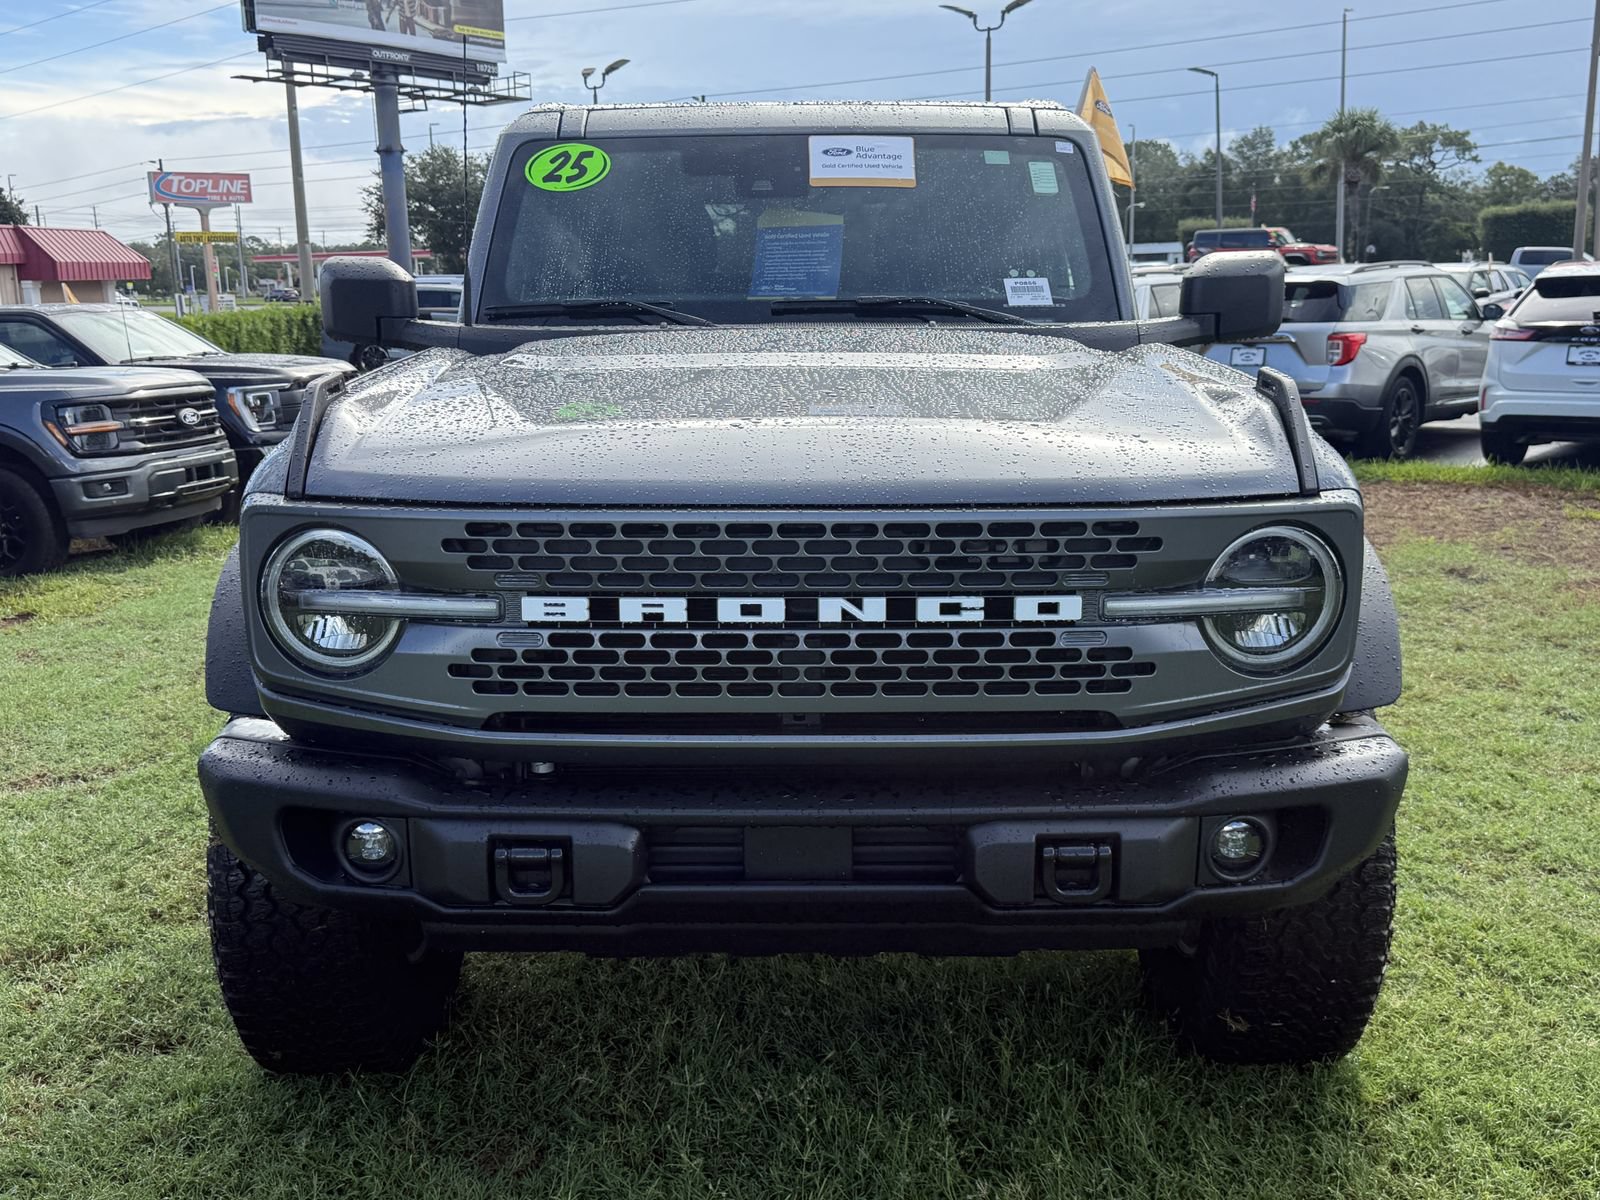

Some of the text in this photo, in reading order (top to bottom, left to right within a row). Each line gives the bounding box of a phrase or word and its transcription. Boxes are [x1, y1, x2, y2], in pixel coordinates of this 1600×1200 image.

[542, 150, 594, 184] 25
[167, 175, 248, 194] TOPLINE
[521, 596, 1083, 623] BRONCO
